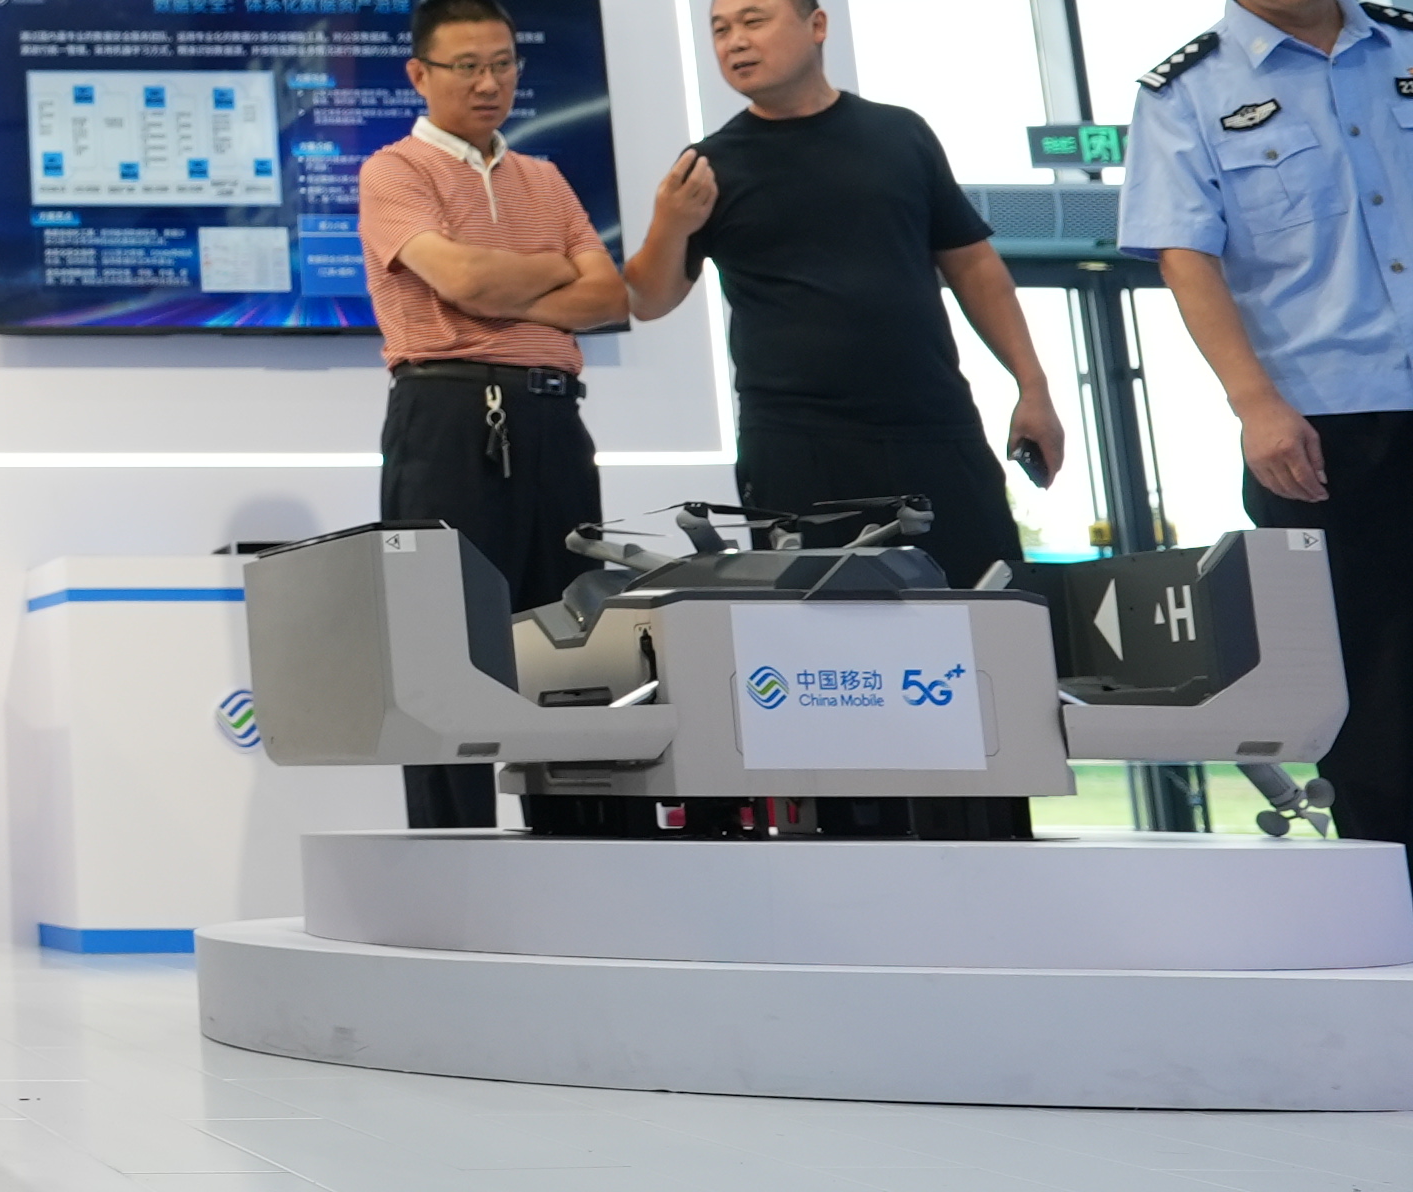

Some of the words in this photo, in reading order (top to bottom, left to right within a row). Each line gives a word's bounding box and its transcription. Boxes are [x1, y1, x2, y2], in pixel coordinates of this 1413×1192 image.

[1166, 584, 1197, 642] H
[796, 668, 883, 691] 中国移动
[799, 693, 838, 707] China
[840, 693, 885, 707] Mobile
